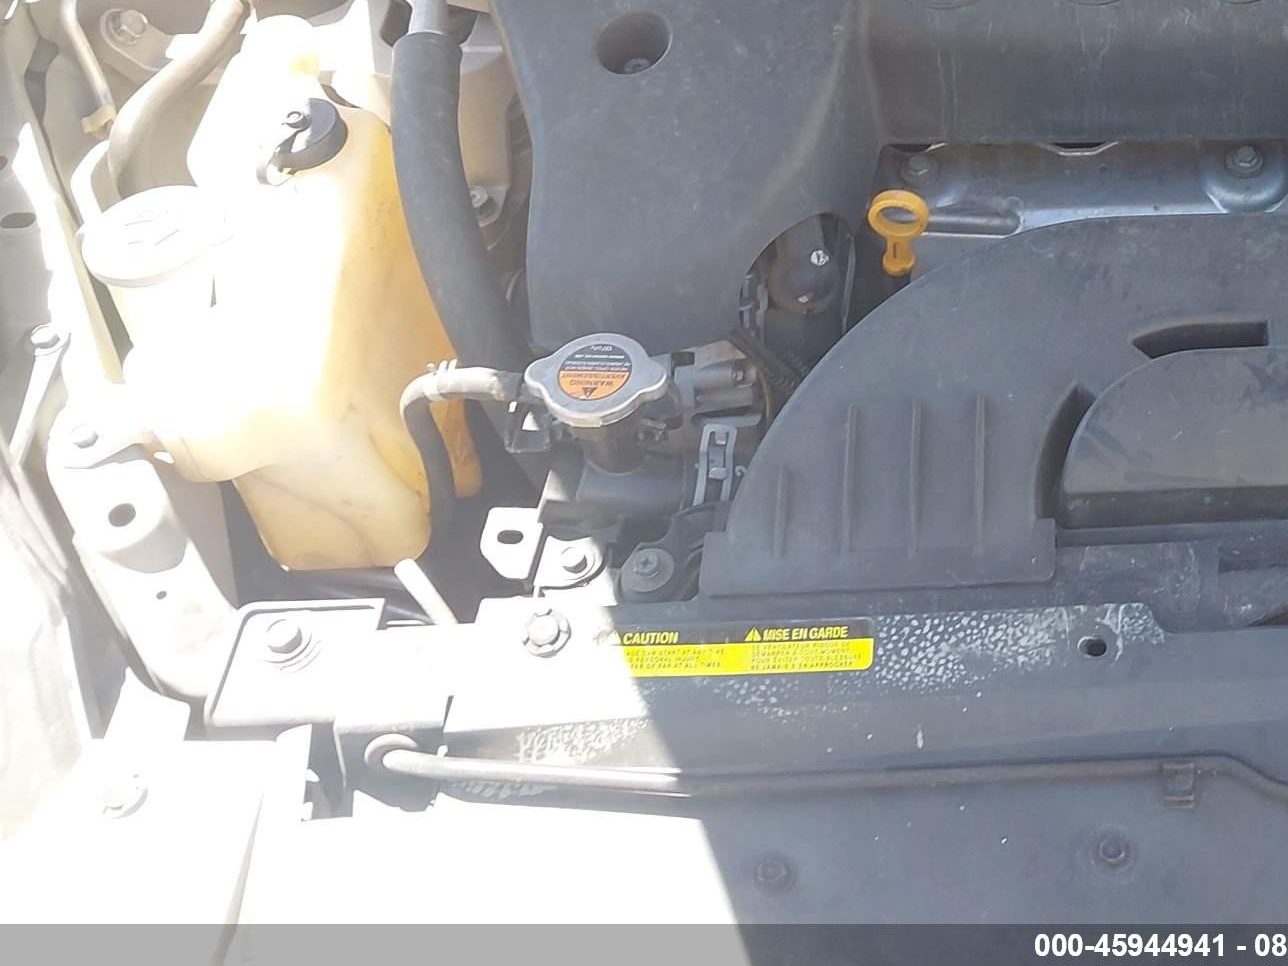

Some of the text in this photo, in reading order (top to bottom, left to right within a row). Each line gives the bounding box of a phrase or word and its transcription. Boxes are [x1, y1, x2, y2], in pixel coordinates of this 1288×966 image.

[623, 631, 679, 645] CAUTION
[763, 626, 849, 641] MISE EN GARDE
